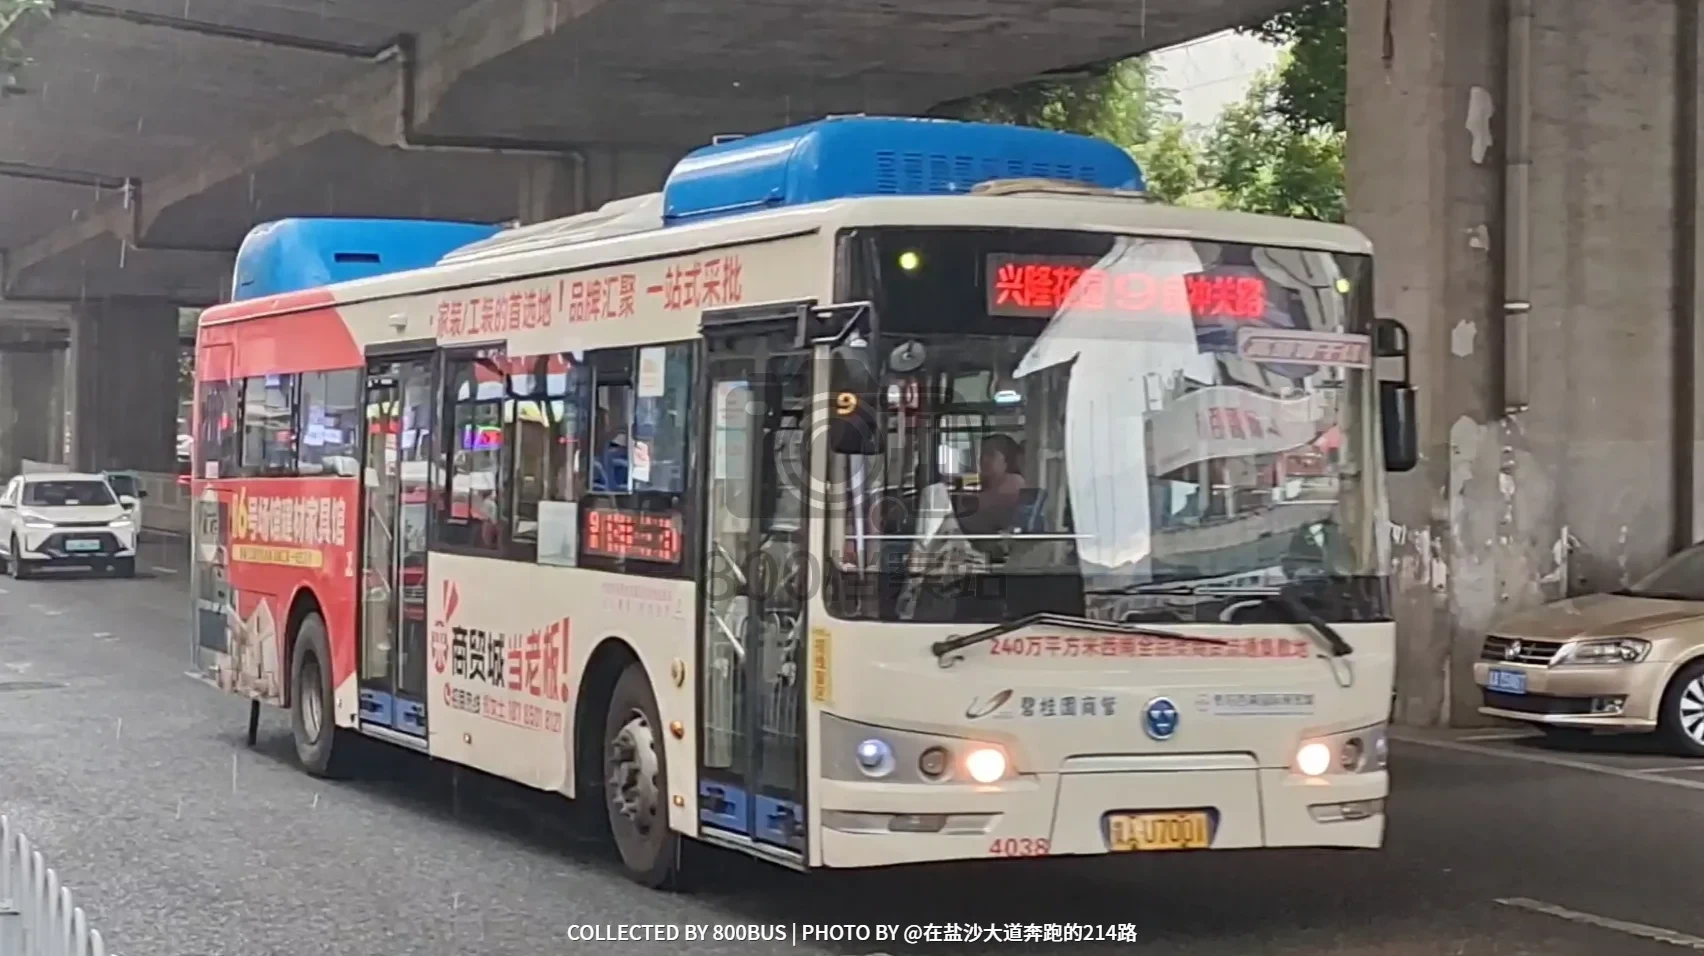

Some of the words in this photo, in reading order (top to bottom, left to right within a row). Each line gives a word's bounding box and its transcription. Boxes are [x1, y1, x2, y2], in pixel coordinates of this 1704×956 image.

[568, 274, 637, 322] 品牌汇聚
[647, 255, 743, 311] 一站式采批
[1115, 272, 1157, 311] 9
[836, 392, 858, 415] 9
[989, 837, 1051, 857] 4038
